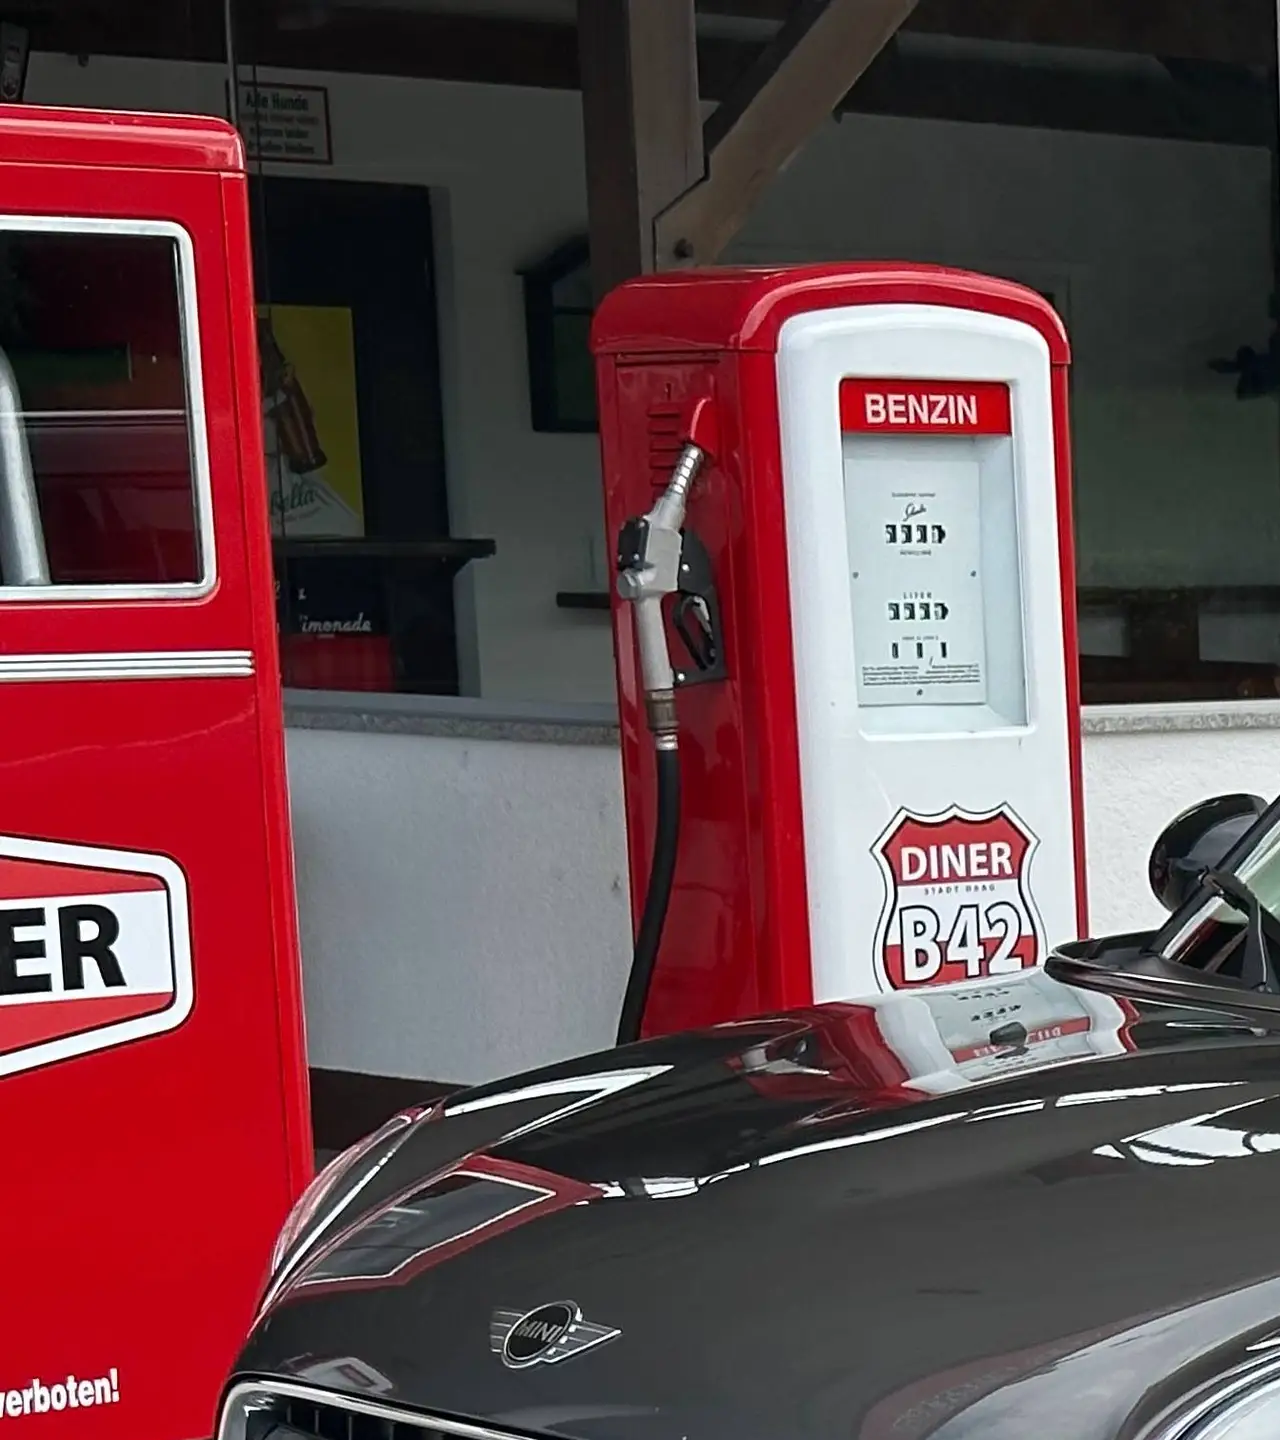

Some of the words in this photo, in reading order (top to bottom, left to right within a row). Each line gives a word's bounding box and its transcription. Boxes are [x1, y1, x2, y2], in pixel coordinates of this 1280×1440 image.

[864, 393, 978, 425] BENZIN
[299, 611, 372, 633] imonade
[900, 841, 1013, 882] DINER
[899, 900, 1025, 984] B42
[514, 1319, 564, 1342] MINI
